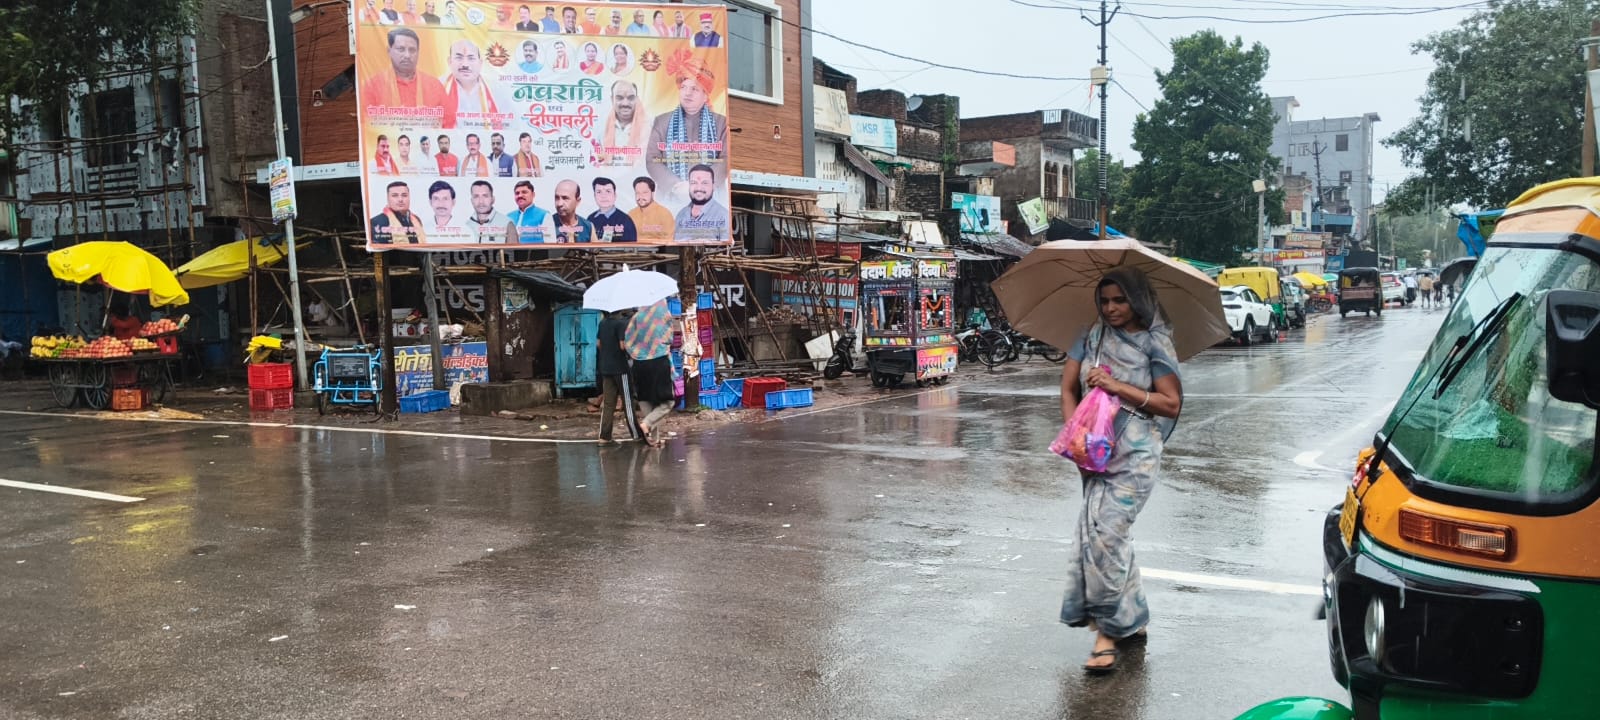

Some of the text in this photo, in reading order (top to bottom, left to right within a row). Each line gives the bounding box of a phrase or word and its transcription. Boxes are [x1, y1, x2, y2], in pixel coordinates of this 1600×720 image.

[513, 78, 603, 102] नवरात्रि
[523, 103, 599, 138] दीपावली
[863, 123, 878, 133] KSR
[548, 135, 582, 154] हार्दिक
[861, 261, 912, 280] बदाम शेक
[919, 260, 942, 279] दिव्या
